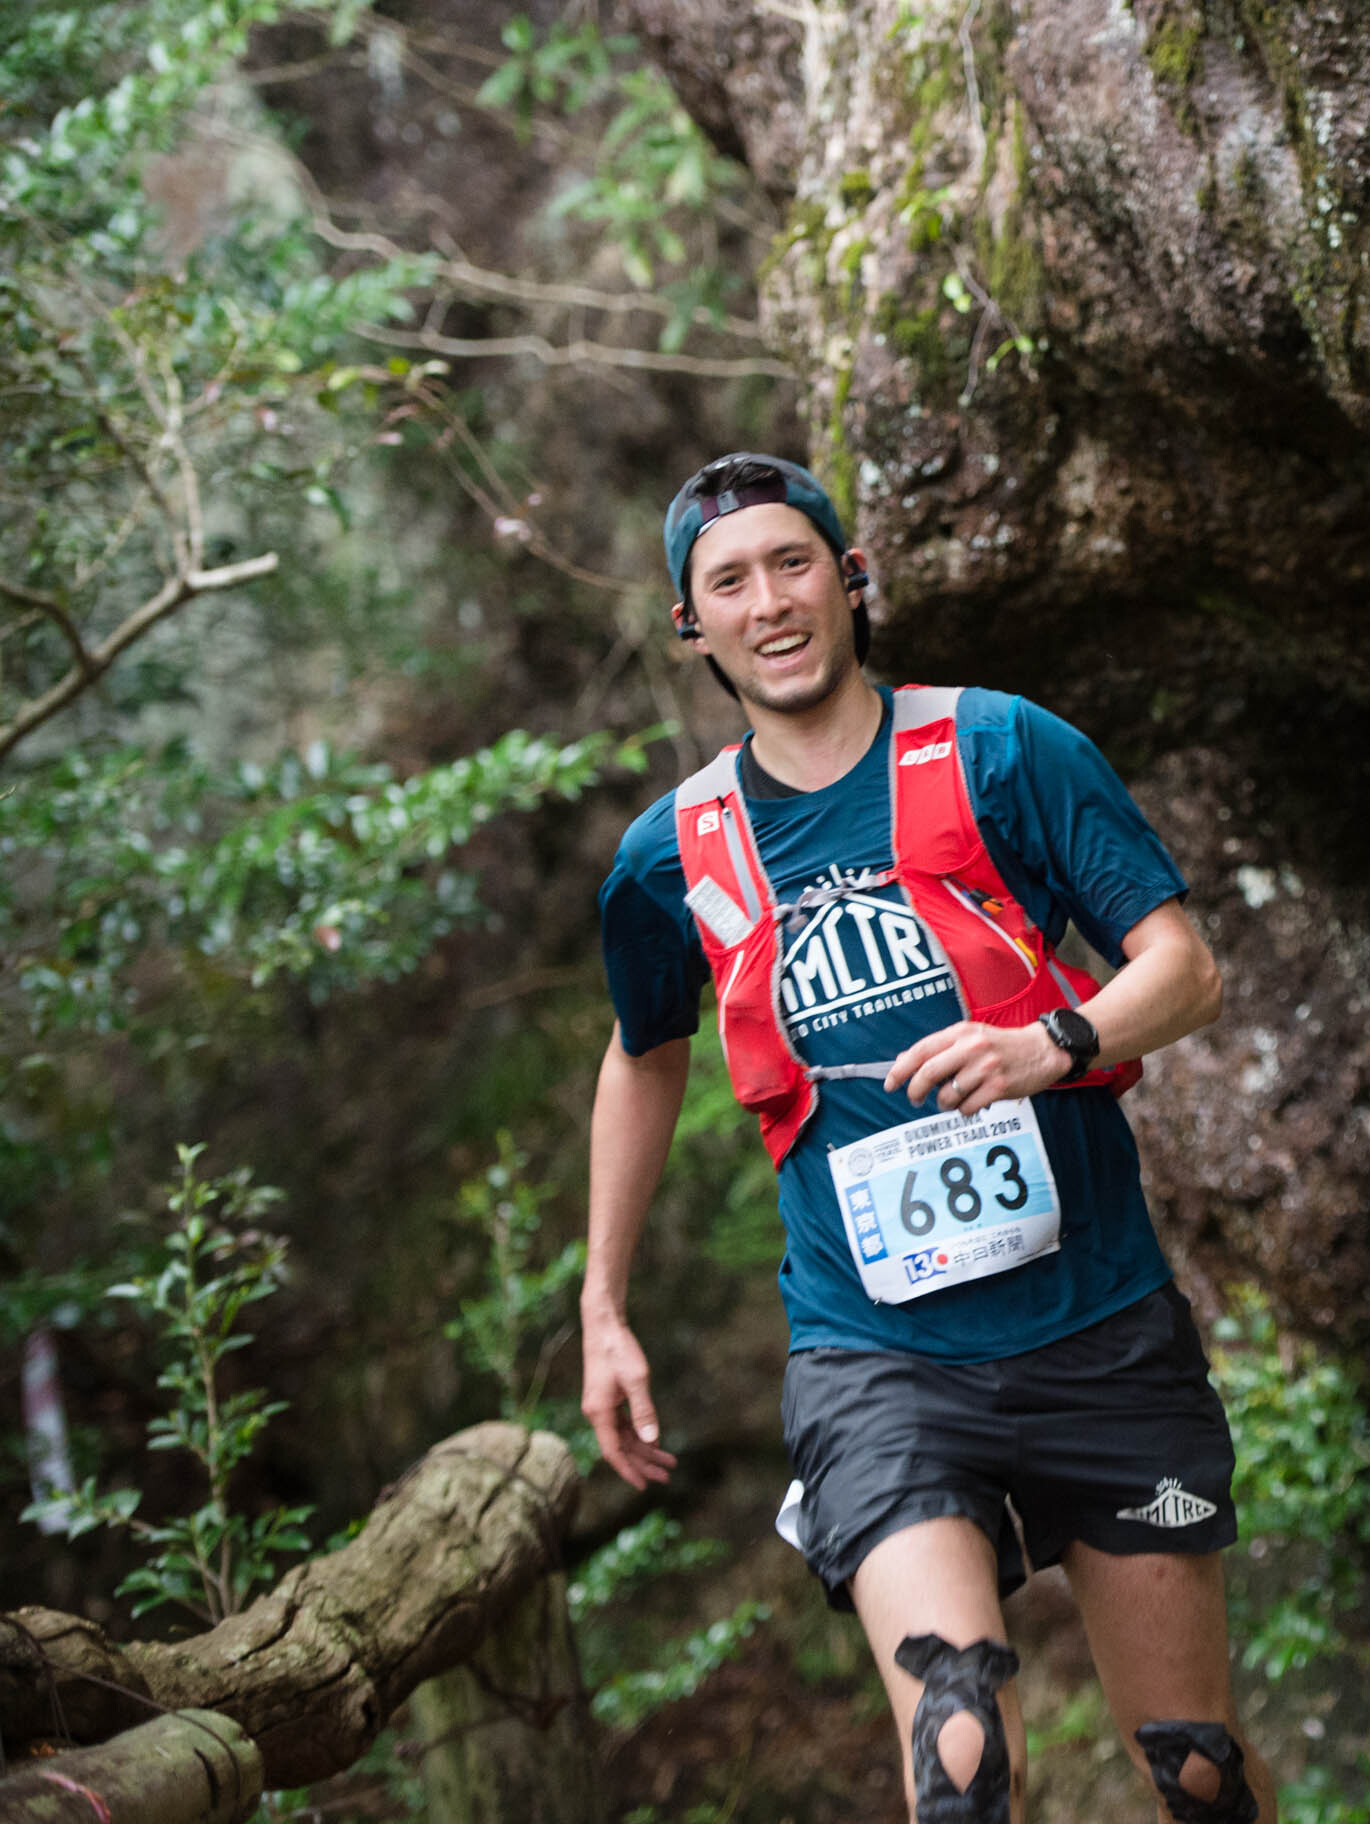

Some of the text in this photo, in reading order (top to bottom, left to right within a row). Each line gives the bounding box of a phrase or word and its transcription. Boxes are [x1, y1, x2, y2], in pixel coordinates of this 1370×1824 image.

[812, 1010, 849, 1032] CITY
[904, 1114, 983, 1143] OKUMIKAWA
[908, 1137, 954, 1158] POWER
[955, 1128, 989, 1149] TRAIL
[991, 1118, 1022, 1137] 2016
[901, 1144, 1028, 1236] 683
[953, 1234, 1025, 1267] 中日新聞
